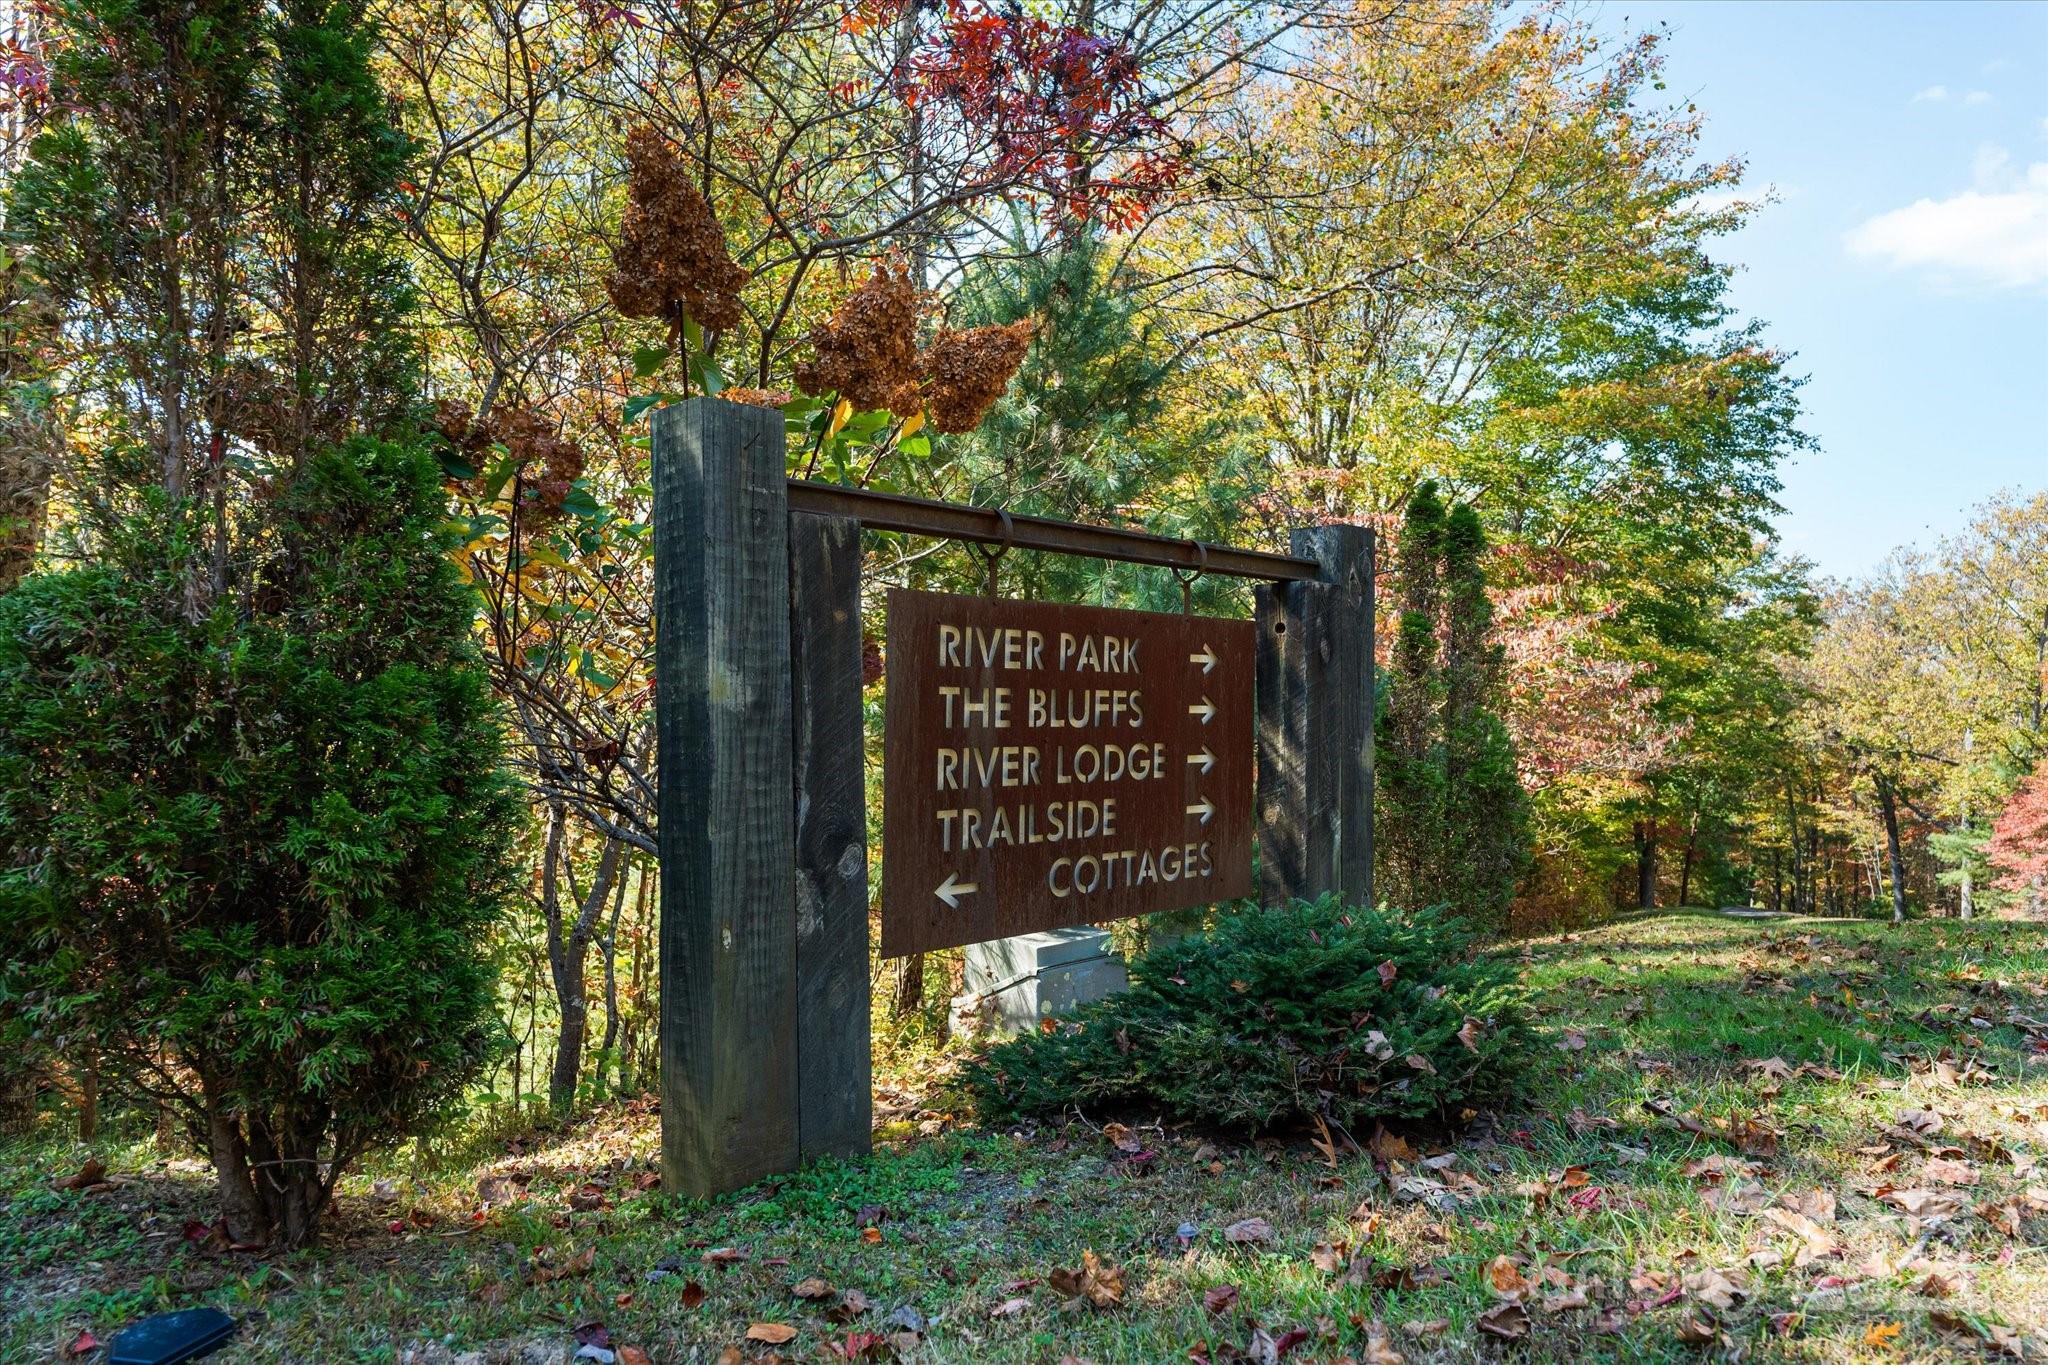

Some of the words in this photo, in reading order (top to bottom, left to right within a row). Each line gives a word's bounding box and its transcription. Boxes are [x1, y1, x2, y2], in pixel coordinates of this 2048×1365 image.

[938, 624, 1044, 670] RIVER
[1060, 632, 1141, 674] PARK
[938, 686, 1012, 729] THE
[1028, 688, 1144, 728] BLUFFS
[937, 746, 1041, 791] RIVER
[1057, 742, 1166, 784] LODGE
[936, 798, 1117, 852] TRAILSIDE
[1048, 842, 1214, 898] COTTAGES
